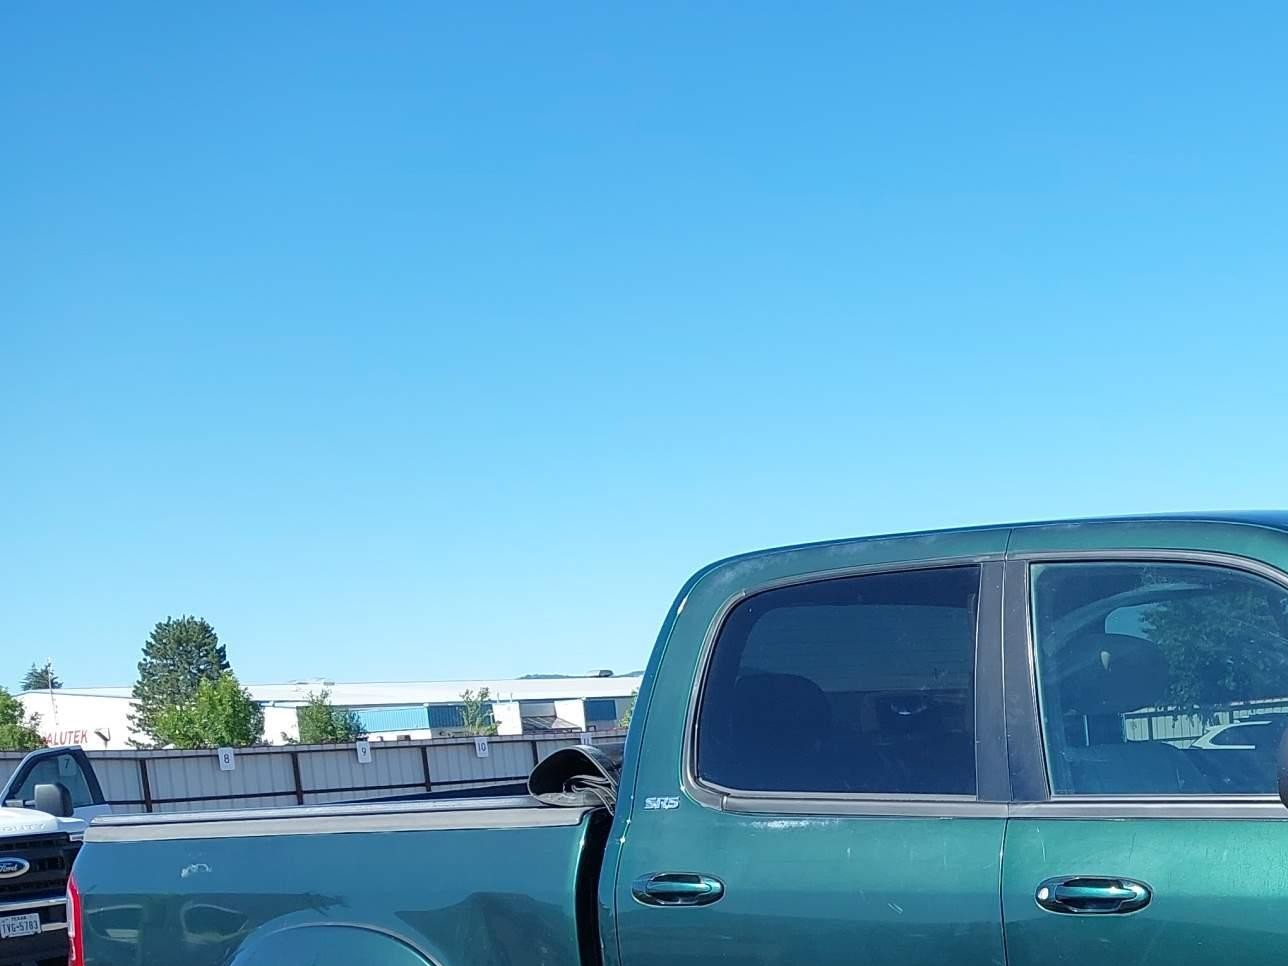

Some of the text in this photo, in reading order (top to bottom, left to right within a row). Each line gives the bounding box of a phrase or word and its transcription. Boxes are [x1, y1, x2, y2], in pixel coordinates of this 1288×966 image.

[361, 747, 367, 757] 9
[477, 742, 487, 752] 10
[223, 753, 230, 763] 8
[644, 796, 680, 810] SR5
